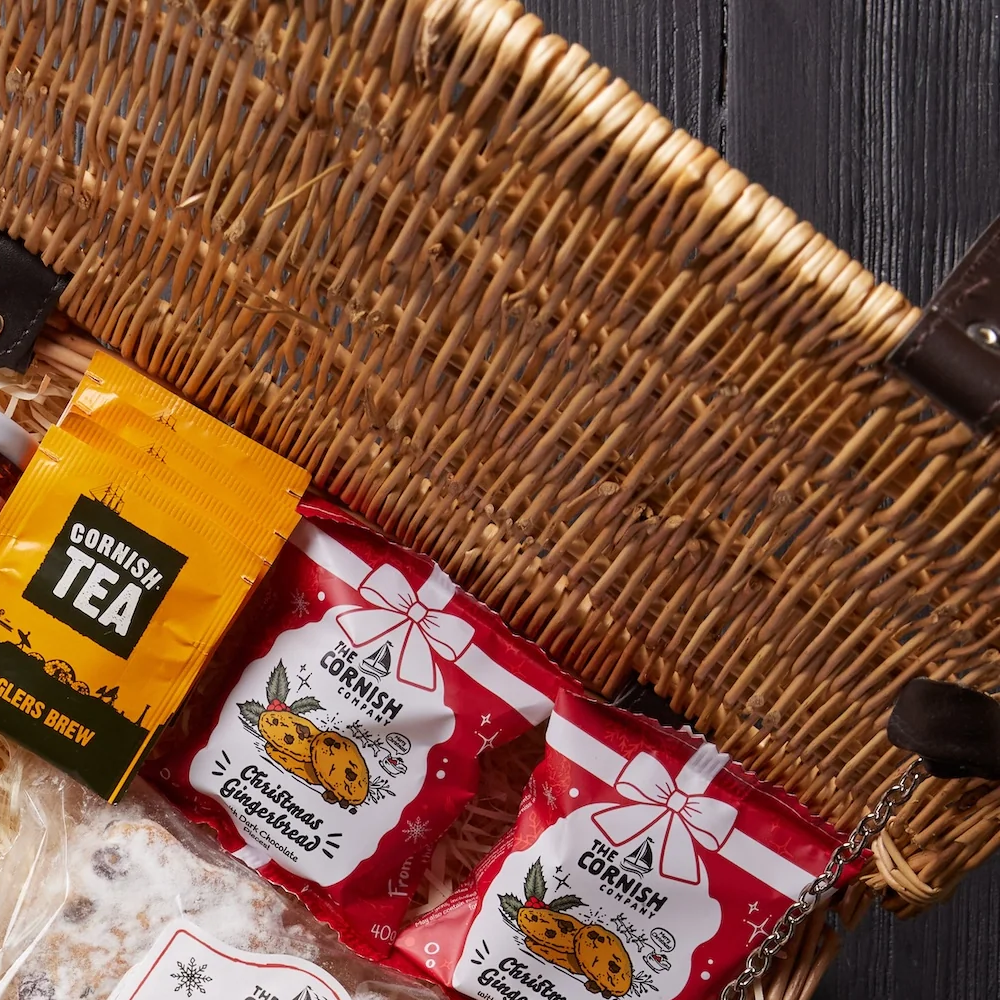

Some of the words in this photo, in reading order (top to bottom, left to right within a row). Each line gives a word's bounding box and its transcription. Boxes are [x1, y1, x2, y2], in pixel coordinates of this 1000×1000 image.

[70, 523, 163, 590] CORNISH
[52, 545, 143, 637] TEA
[334, 640, 358, 664] THE
[320, 651, 403, 720] CORNISH
[337, 687, 391, 727] COMPANY
[43, 709, 96, 747] BREW
[220, 778, 321, 852] Gingerbread
[240, 765, 324, 830] Christmas
[239, 814, 259, 833] Dark
[260, 830, 298, 863] Chocolate
[243, 826, 270, 851] Pieces!
[591, 839, 619, 863] THE
[387, 856, 414, 897] From
[577, 851, 668, 912] CORNISH
[599, 884, 656, 919] COMPANY
[371, 923, 397, 946] 40g
